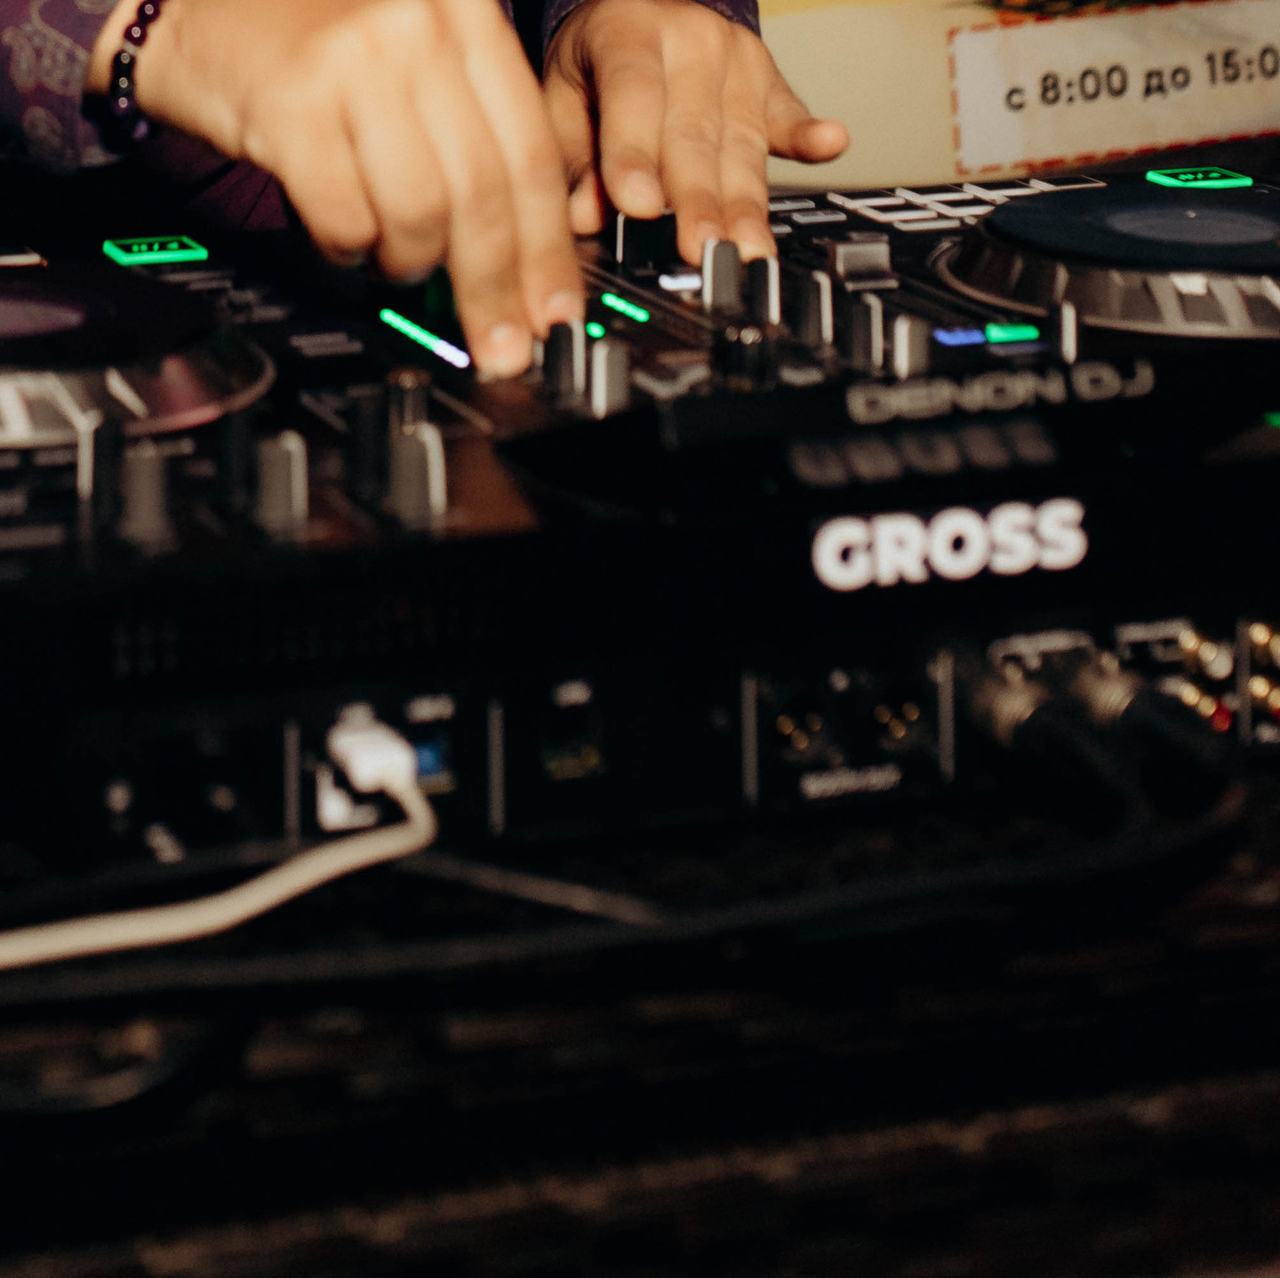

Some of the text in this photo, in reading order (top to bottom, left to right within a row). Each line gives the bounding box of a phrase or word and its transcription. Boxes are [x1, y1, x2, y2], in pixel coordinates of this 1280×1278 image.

[1005, 86, 1026, 112] с
[1039, 63, 1130, 107] 8:00
[1142, 65, 1191, 100] до
[810, 496, 1090, 593] GROSS
